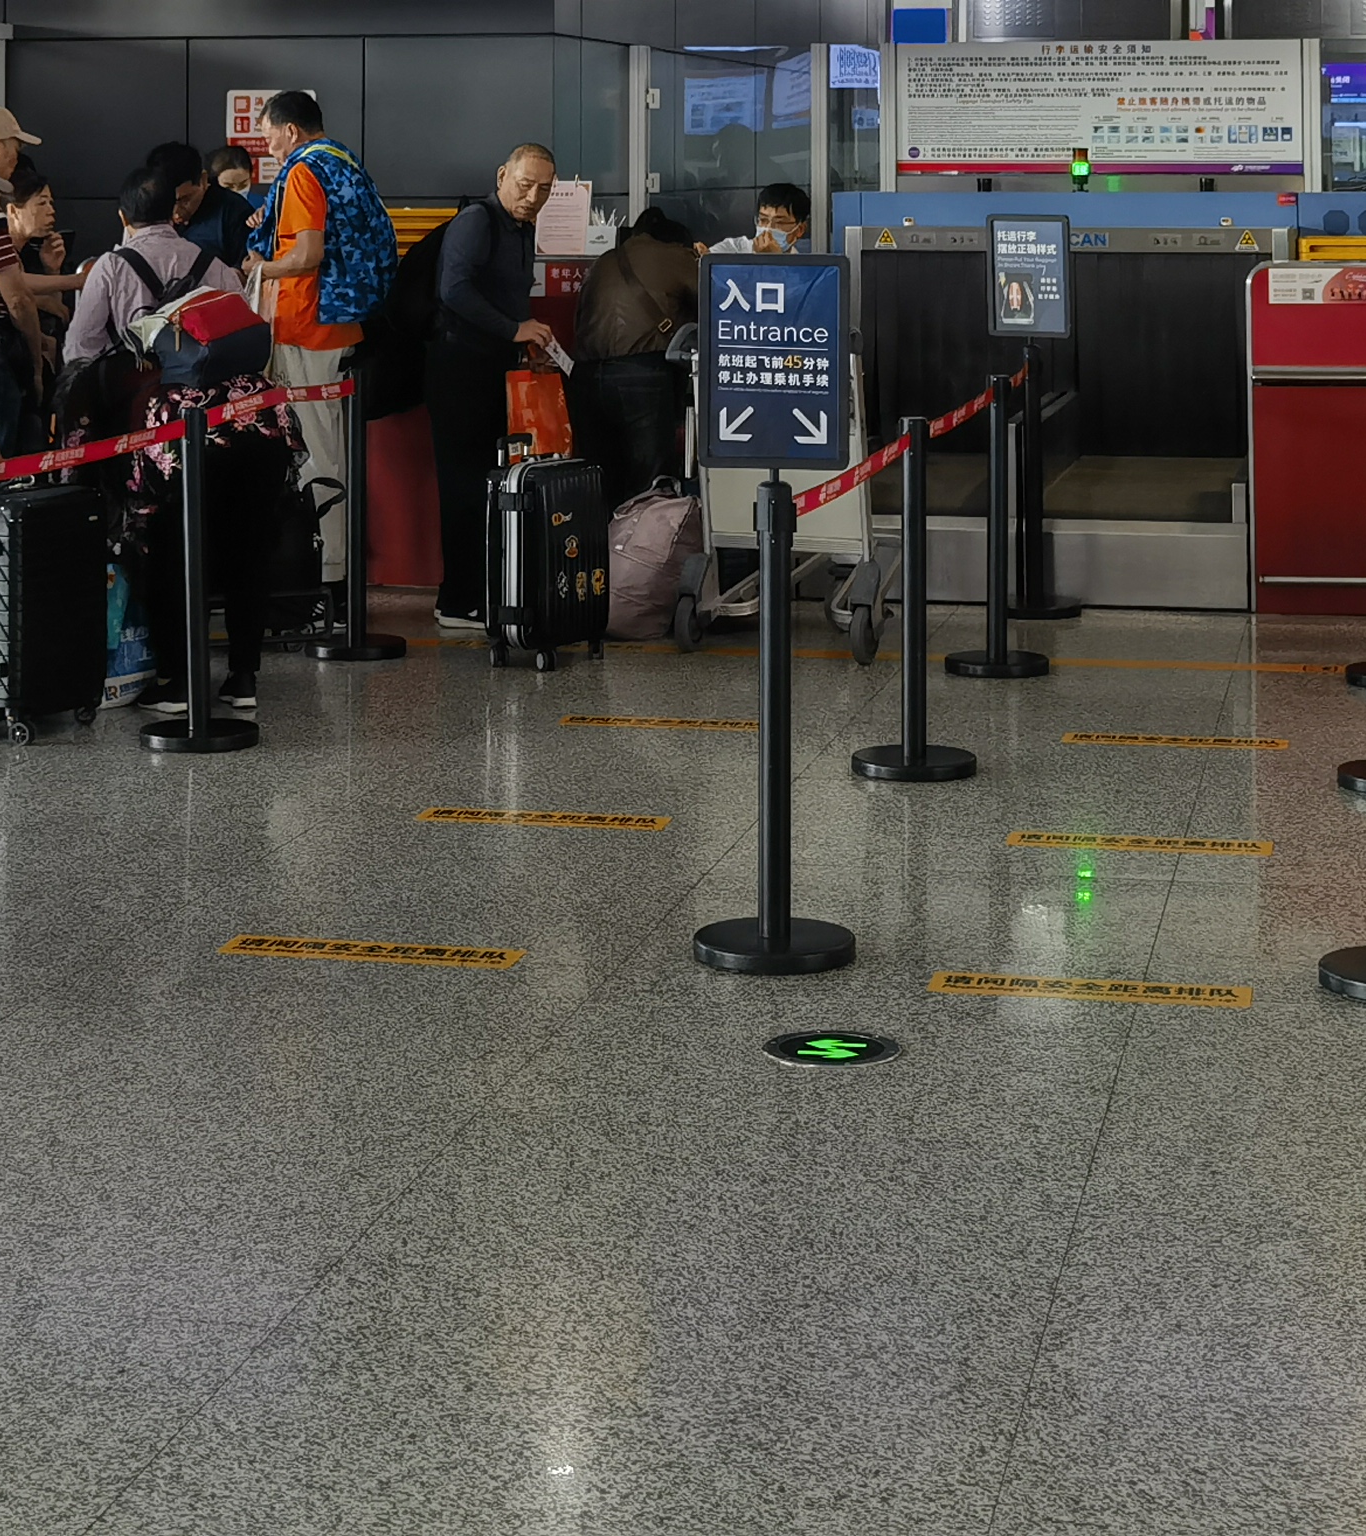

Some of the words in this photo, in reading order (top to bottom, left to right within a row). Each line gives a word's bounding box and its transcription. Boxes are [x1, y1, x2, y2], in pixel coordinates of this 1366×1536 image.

[1041, 44, 1152, 55] 行李运输安全须知
[718, 278, 785, 314] 入口
[717, 319, 829, 343] Entrance
[718, 353, 830, 371] 航班起飞前45分钟
[718, 370, 829, 387] 停止办理乘机手续
[237, 937, 508, 961] 请间隔安全距离排队
[943, 974, 1239, 998] 请间隔安全距离排队
